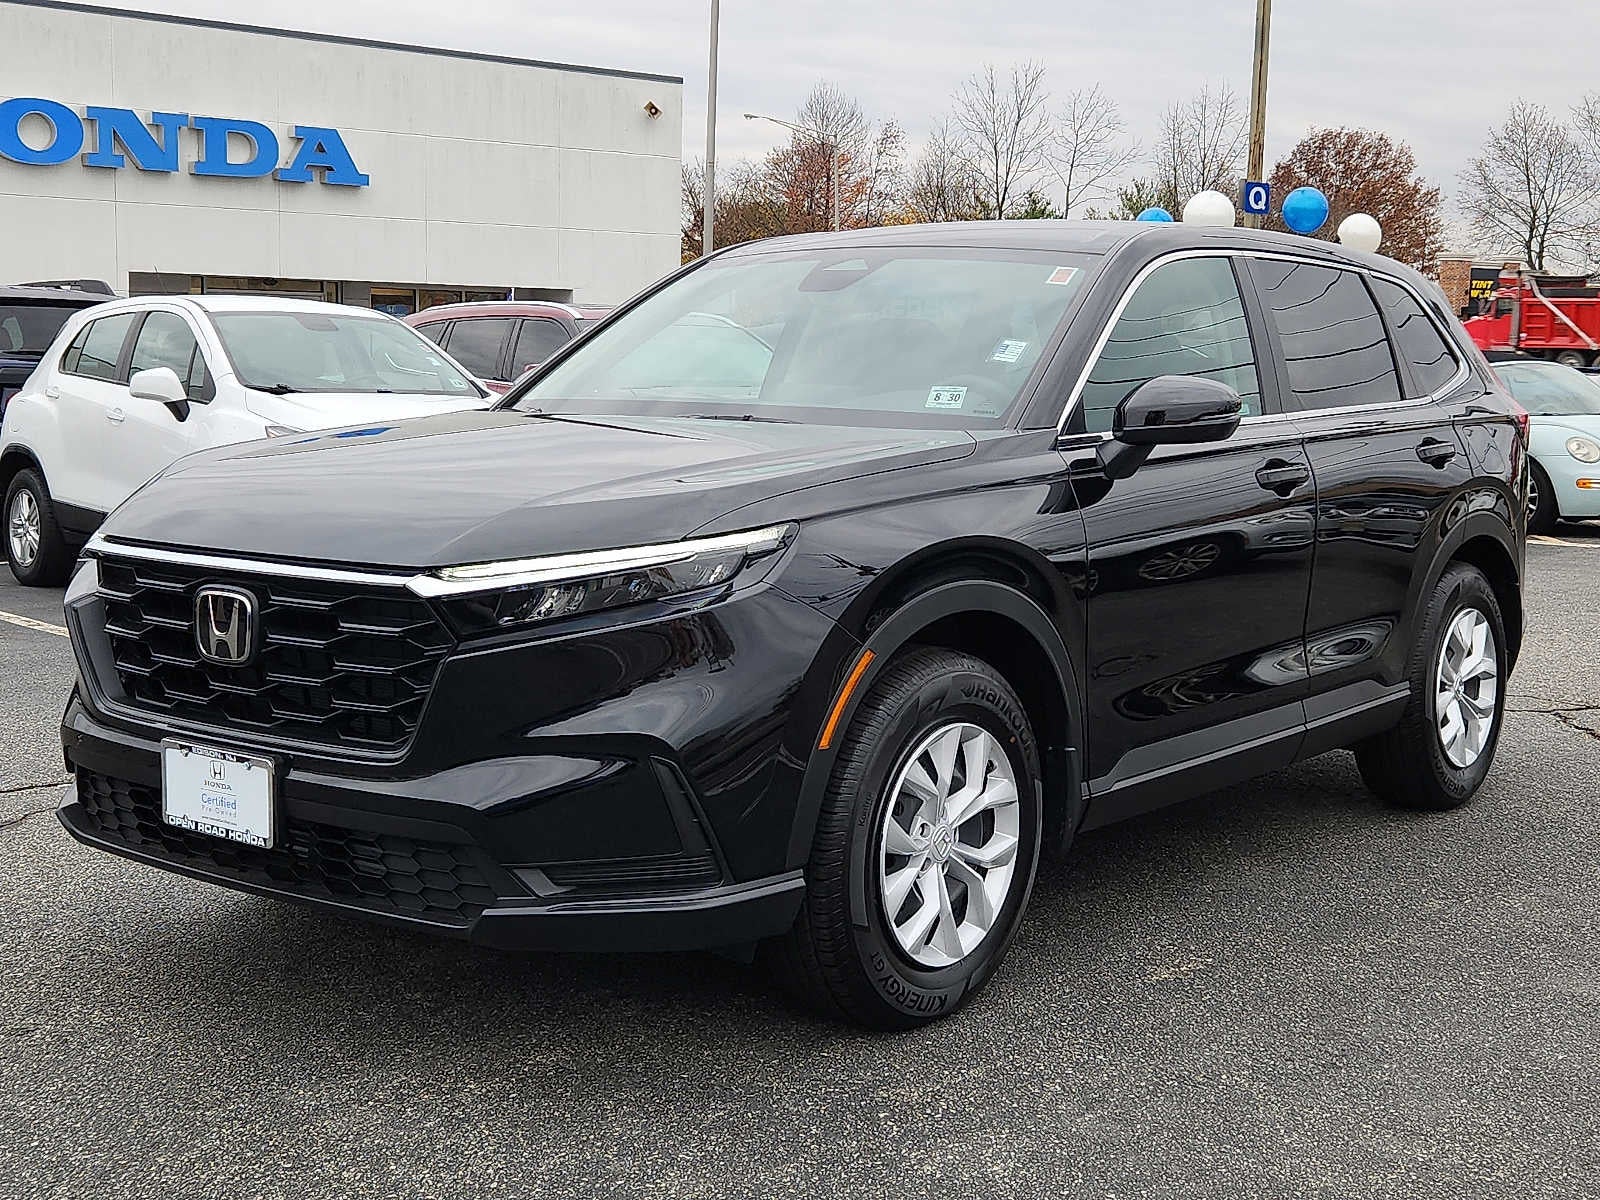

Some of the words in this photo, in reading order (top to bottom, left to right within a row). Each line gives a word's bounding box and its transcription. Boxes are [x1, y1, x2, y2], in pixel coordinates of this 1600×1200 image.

[1249, 187, 1267, 210] Q
[1471, 280, 1494, 289] TINT
[947, 393, 961, 402] 30
[225, 754, 237, 762] NJ
[204, 780, 232, 790] HONDA
[201, 793, 237, 810] Certified
[168, 815, 195, 829] OPEN
[197, 823, 226, 837] ROAD
[228, 830, 265, 846] HONDA
[878, 974, 949, 1012] KINERGY
